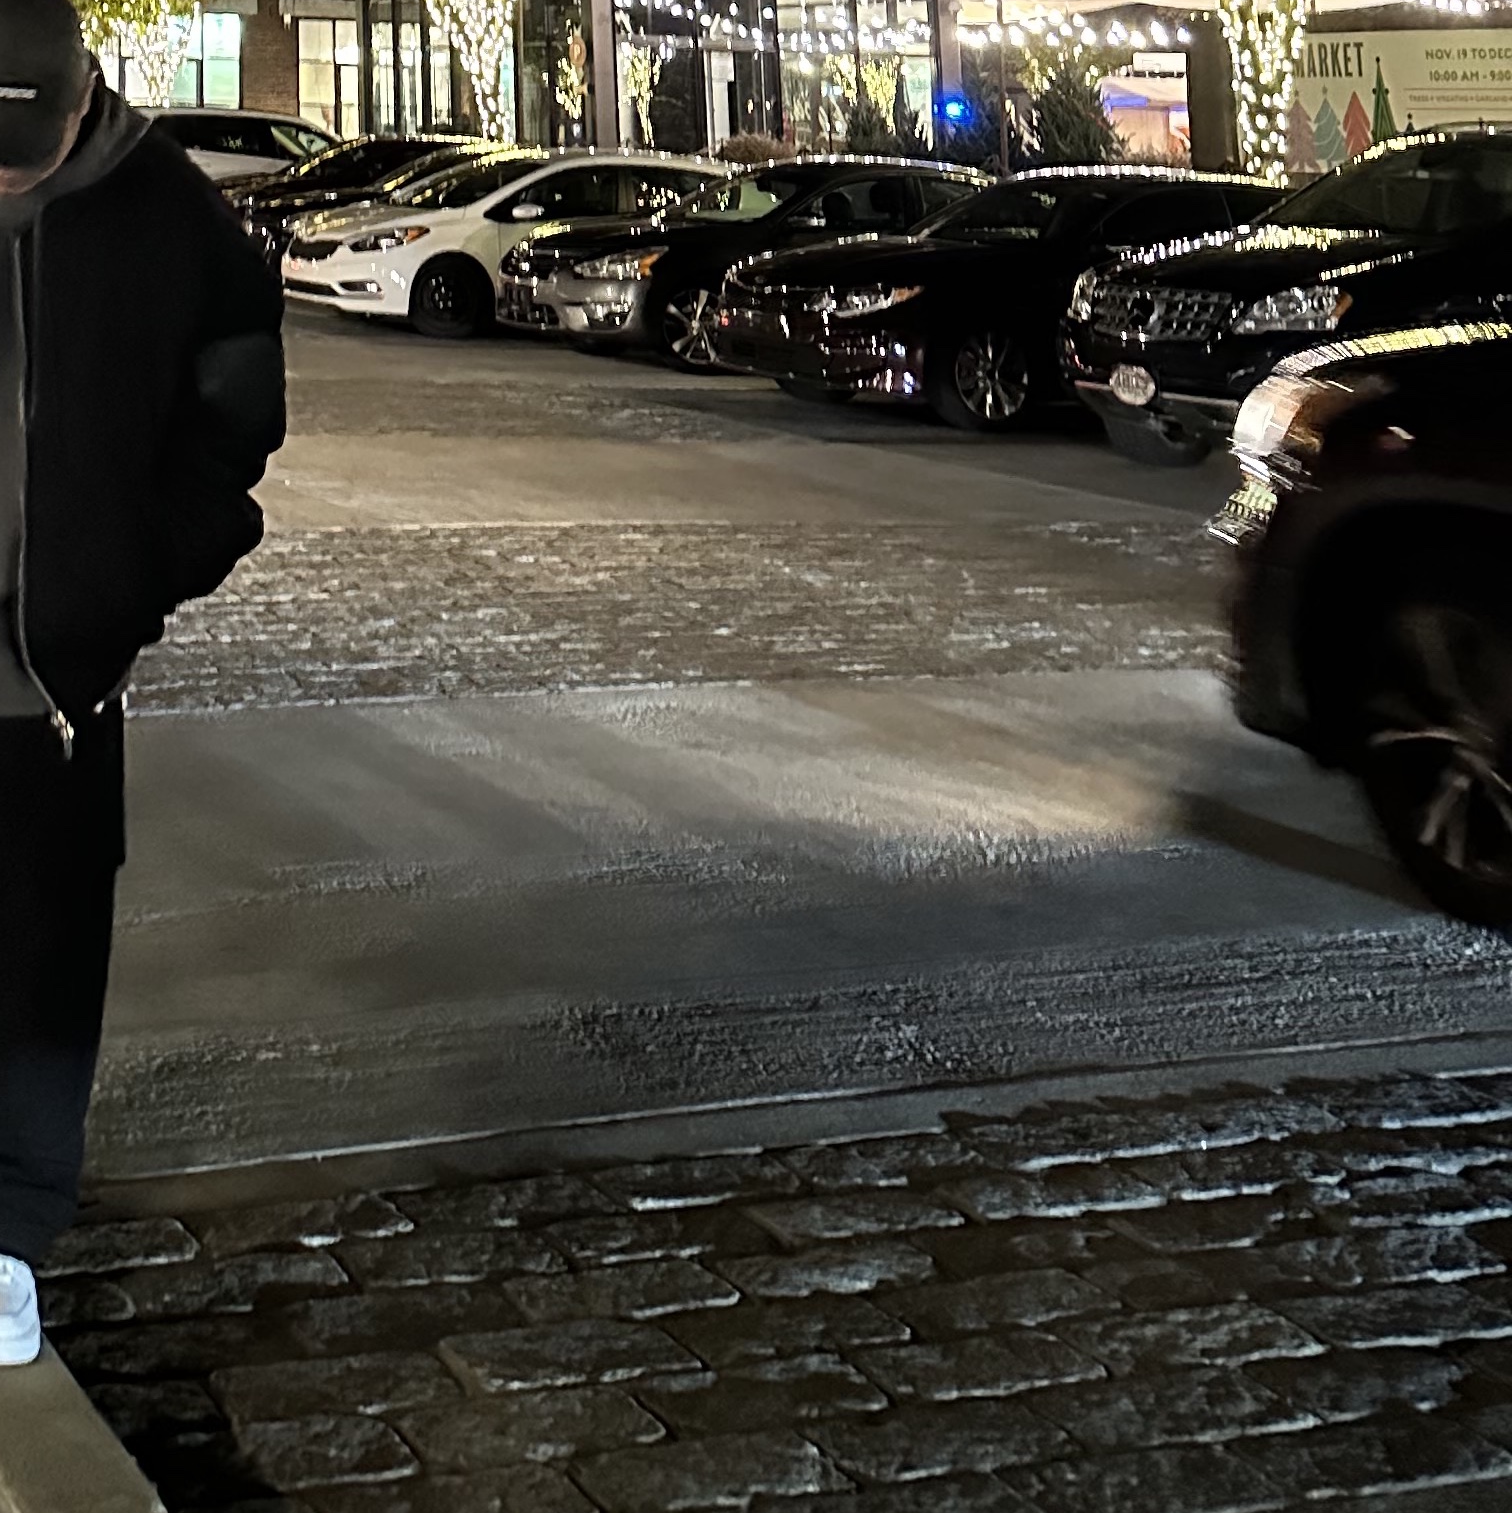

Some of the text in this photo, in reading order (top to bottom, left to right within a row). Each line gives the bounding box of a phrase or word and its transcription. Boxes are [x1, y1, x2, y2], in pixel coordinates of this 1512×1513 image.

[1471, 48, 1487, 59] TO
[1429, 70, 1458, 81] 10:00
[1461, 70, 1480, 81] AM
